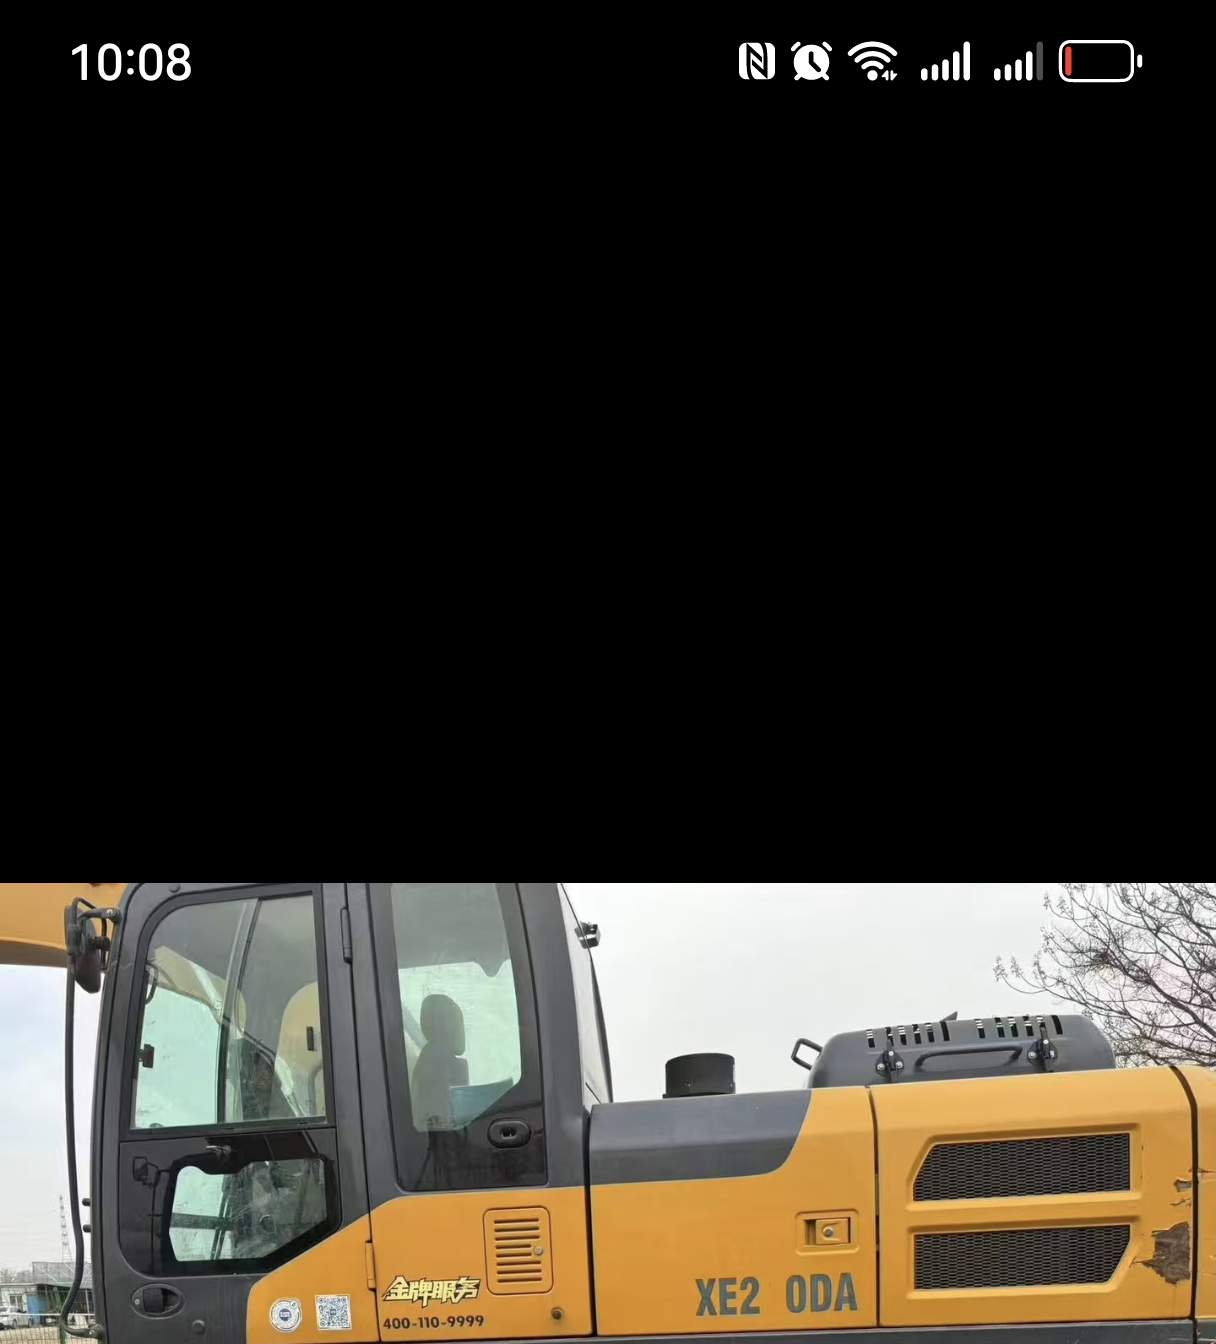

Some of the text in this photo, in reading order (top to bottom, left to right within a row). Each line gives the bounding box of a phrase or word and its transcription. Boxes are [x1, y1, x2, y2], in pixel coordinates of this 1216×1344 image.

[382, 1275, 481, 1308] 金牌服务
[383, 1314, 485, 1330] 400-110-9999
